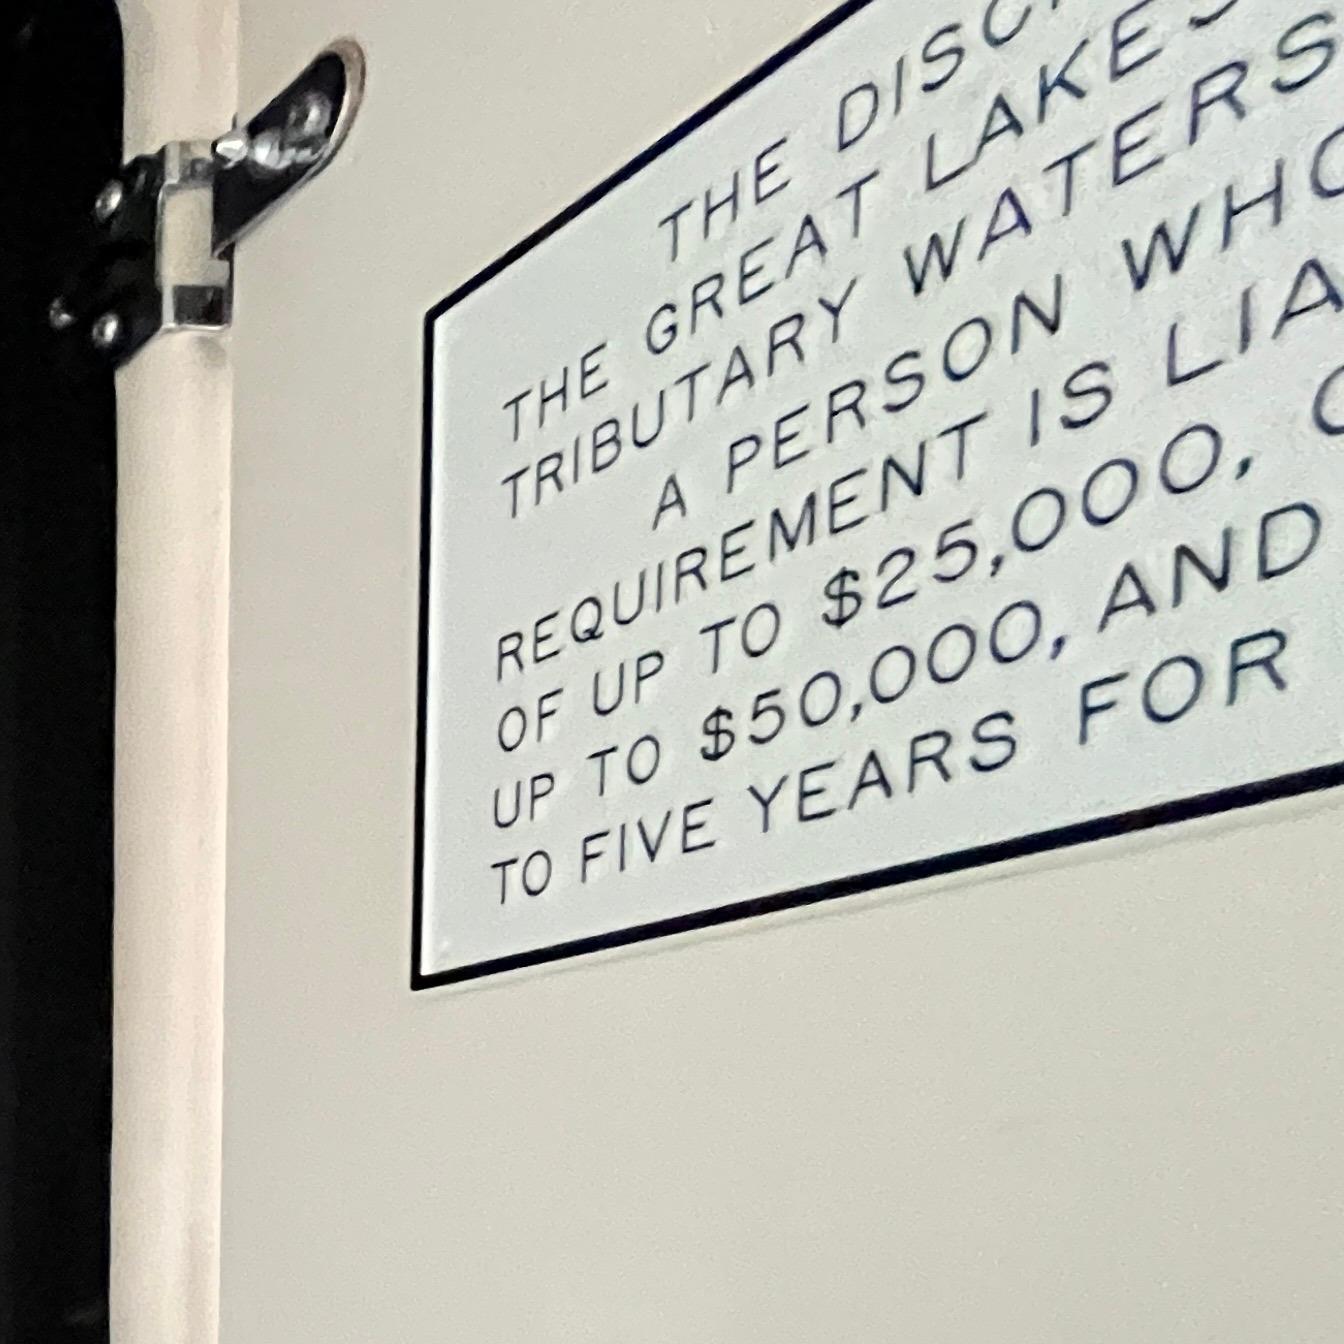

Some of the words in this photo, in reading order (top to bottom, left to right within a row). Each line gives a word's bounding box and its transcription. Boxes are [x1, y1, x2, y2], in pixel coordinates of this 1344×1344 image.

[658, 136, 791, 264] THE
[837, 0, 1059, 152] DISC
[501, 278, 859, 520] TRIBUTARY
[502, 342, 609, 445] THE
[645, 171, 880, 357] GREAT
[651, 474, 687, 530] A
[727, 272, 1063, 494] PERSON
[496, 411, 989, 683] REQUIREMENT
[1030, 361, 1113, 446] IS
[491, 849, 553, 907] TO
[579, 800, 717, 883] FIVE
[747, 710, 1018, 834] YEARS
[1076, 627, 1289, 746] FOR
[492, 771, 556, 830] UP
[589, 734, 661, 798] TO
[699, 598, 1066, 763] $50,000,
[1097, 502, 1323, 633] AND
[498, 688, 567, 754] OF
[593, 648, 666, 717] UP
[699, 601, 782, 674] TO
